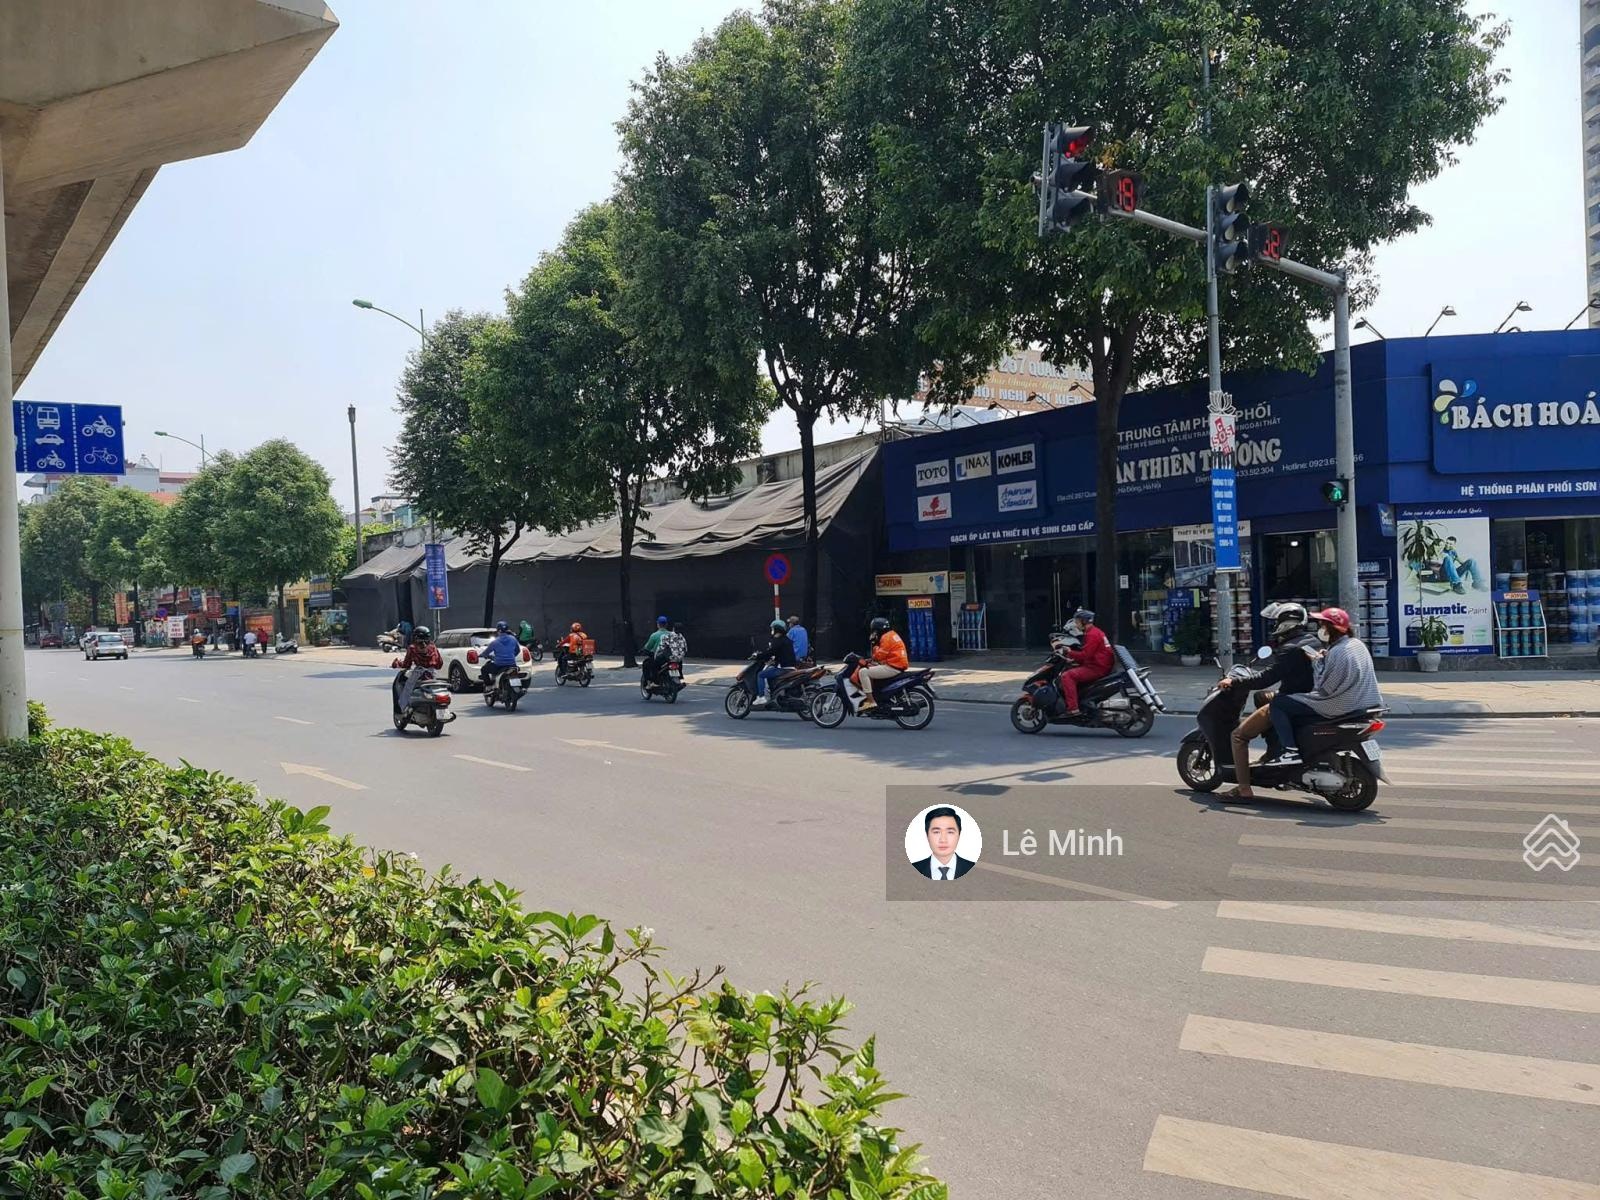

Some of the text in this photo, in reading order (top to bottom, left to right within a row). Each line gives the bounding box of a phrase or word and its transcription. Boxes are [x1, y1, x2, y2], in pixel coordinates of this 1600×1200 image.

[1118, 426, 1161, 443] TRUNG
[1164, 419, 1191, 435] TÂM
[1235, 401, 1271, 422] PHỐI
[1451, 396, 1534, 429] BÁCH
[965, 455, 990, 470] INAX
[998, 450, 1033, 469] KOHLER
[1138, 446, 1196, 481] THIÊN
[918, 466, 948, 480] TOTO
[1461, 480, 1597, 497] HỆ THỐNG PHÂN PHỐI SƠN
[951, 534, 967, 544] GẠCH
[992, 529, 1001, 539] VÀ
[1002, 527, 1020, 538] THIẾT
[1031, 526, 1040, 536] VỆ
[1041, 525, 1060, 535] SINH
[1061, 523, 1077, 533] CAO
[1078, 520, 1095, 531] CẤP
[1404, 603, 1467, 616] Baumatic
